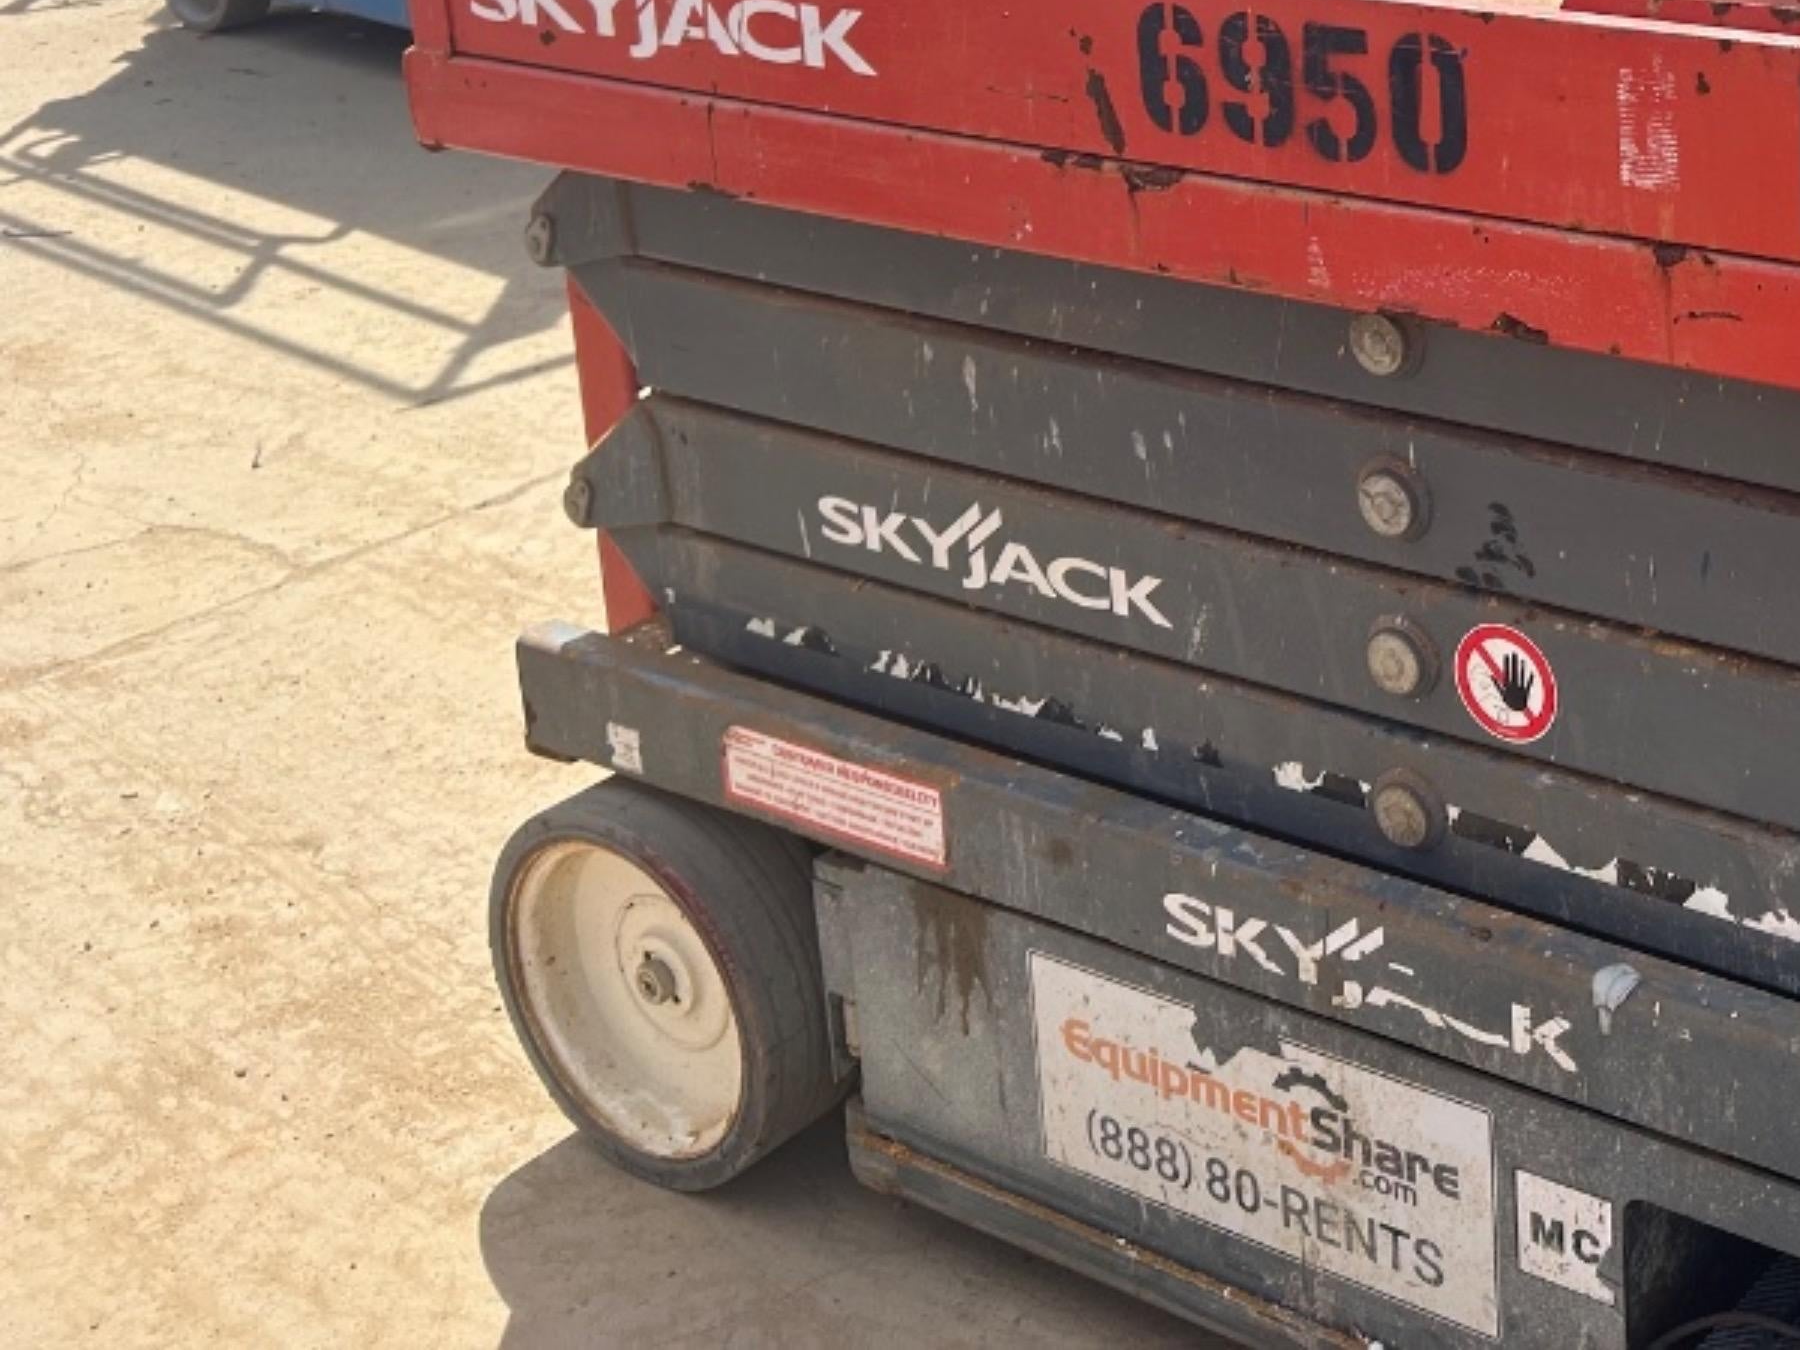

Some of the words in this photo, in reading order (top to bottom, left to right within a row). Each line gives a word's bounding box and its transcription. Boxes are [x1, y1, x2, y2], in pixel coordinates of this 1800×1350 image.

[1135, 1, 1469, 176] 6950
[816, 494, 1174, 630] SKYJACK
[1059, 1017, 1463, 1201] EquipmentShare
[1351, 1163, 1419, 1207] .com
[1085, 1108, 1194, 1190] (888)
[1205, 1158, 1448, 1290] 80-RENTS
[1528, 1210, 1602, 1265] MC
